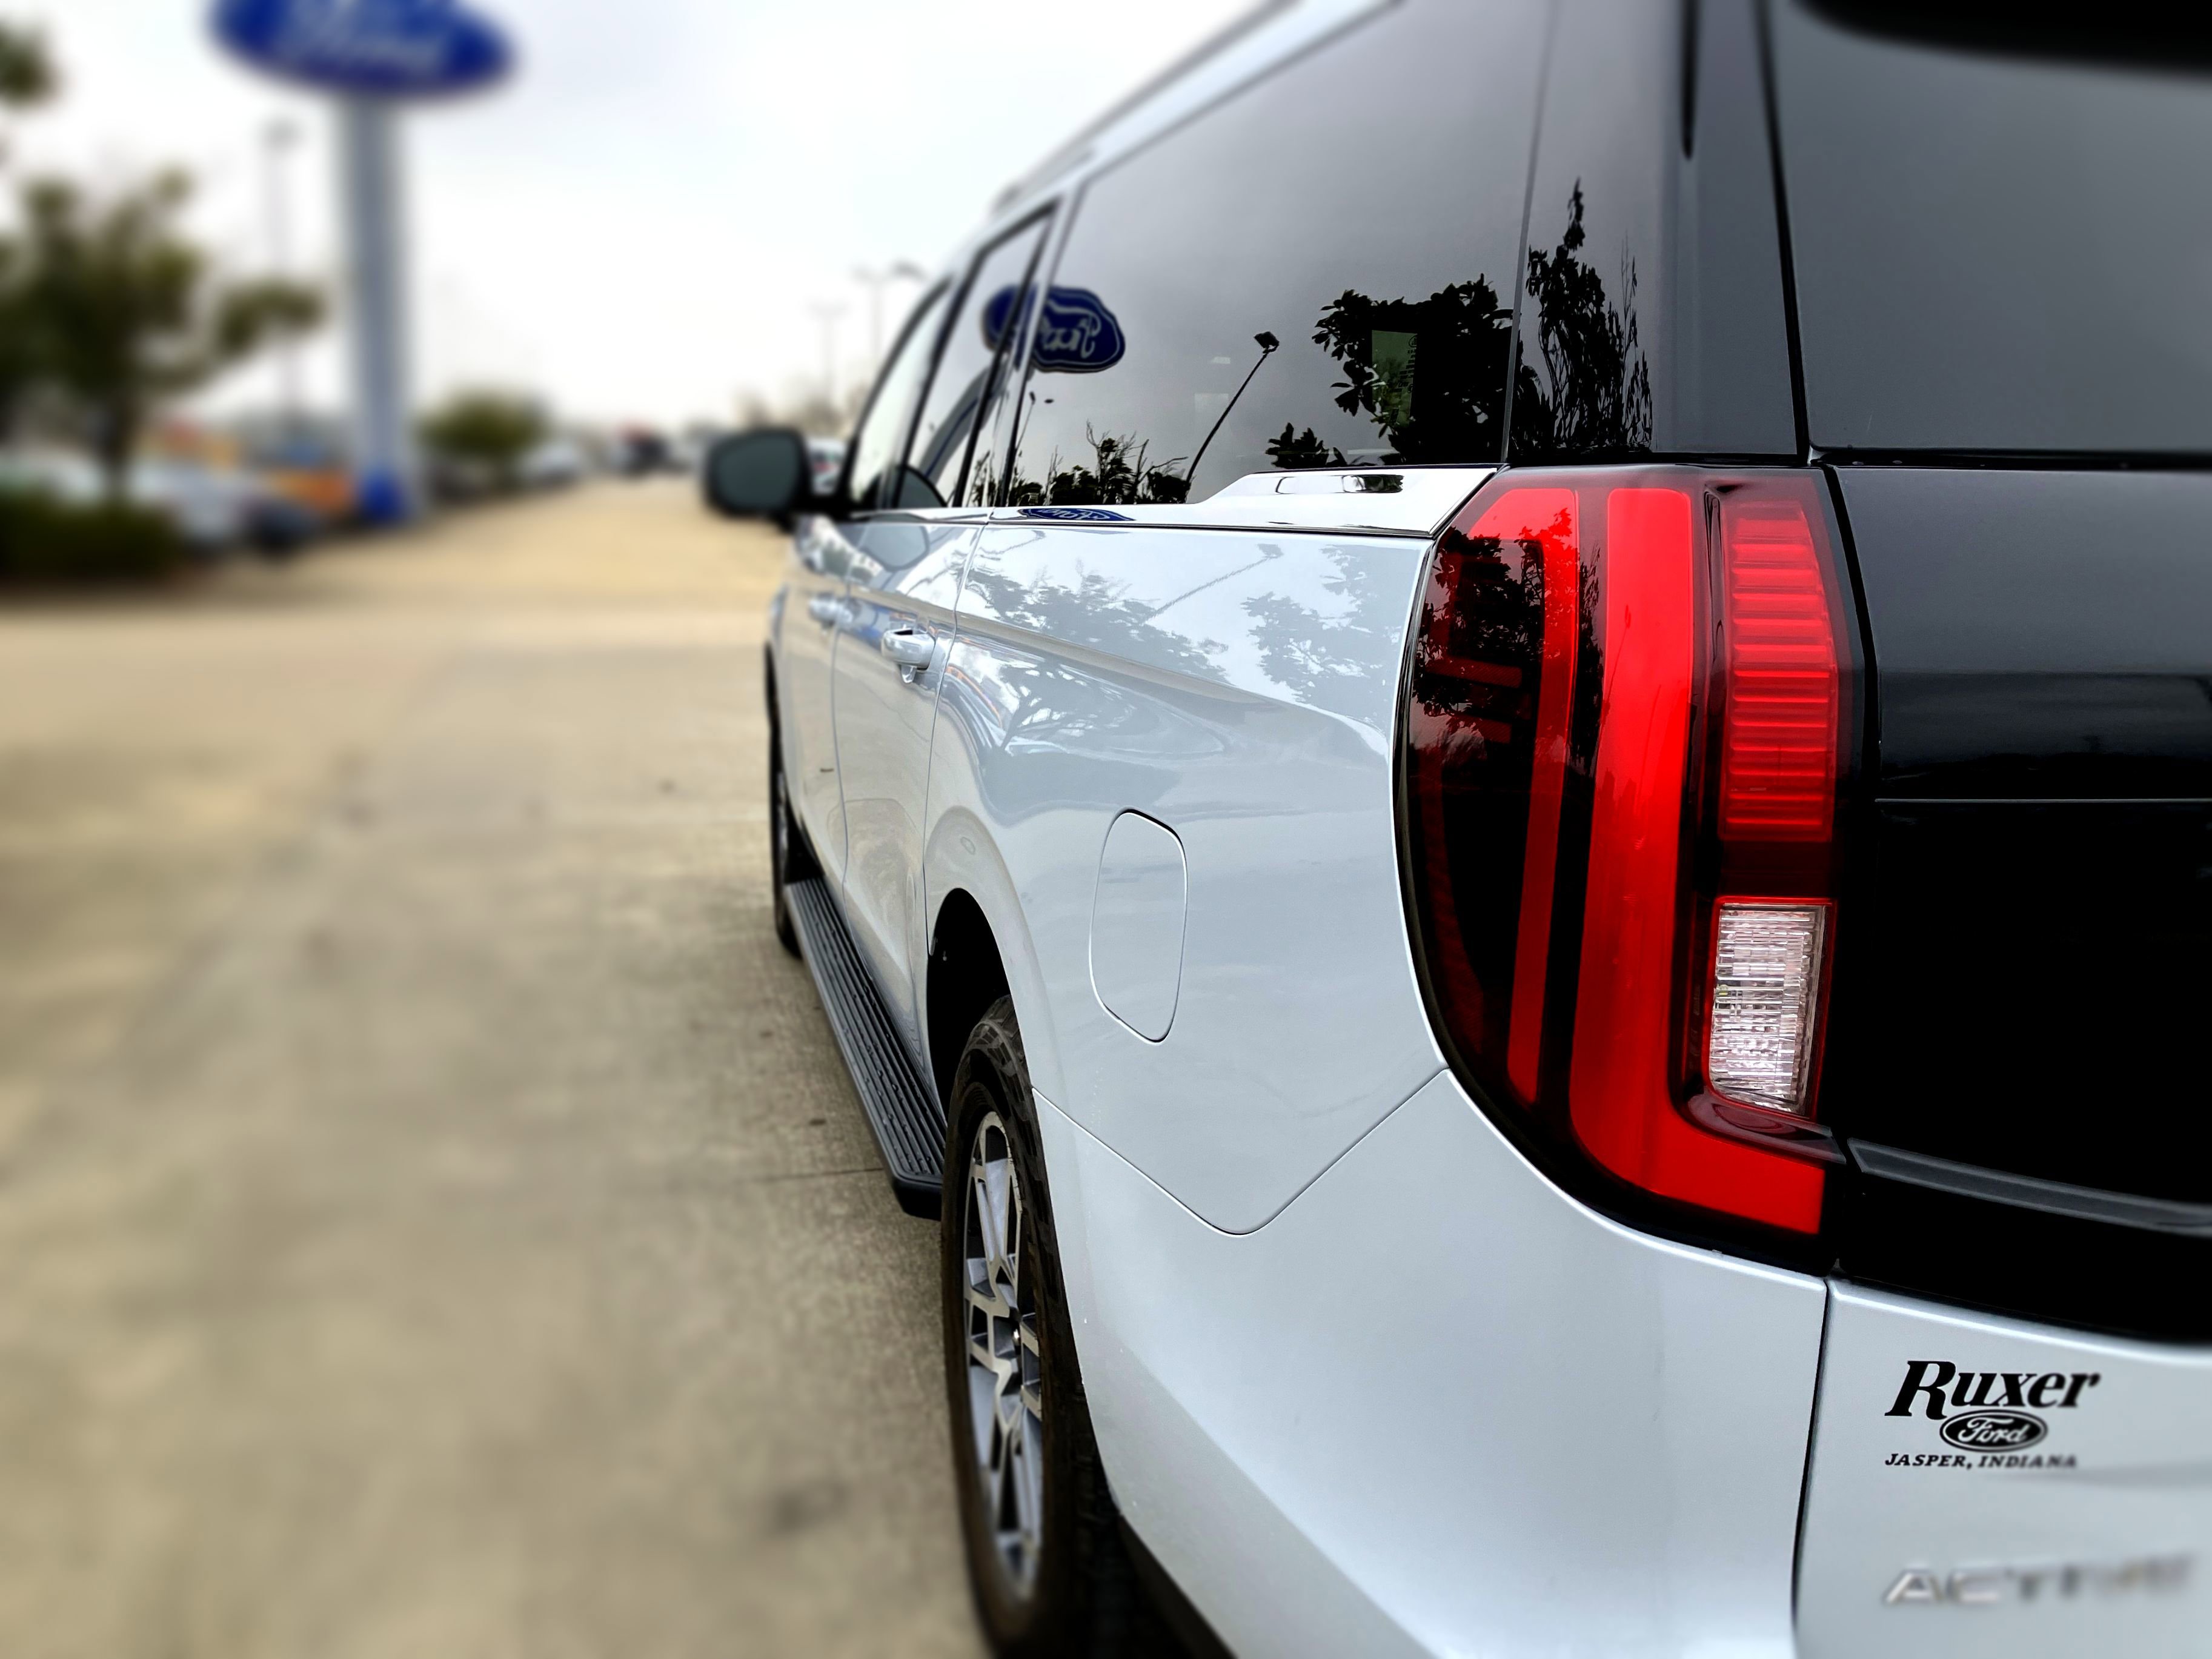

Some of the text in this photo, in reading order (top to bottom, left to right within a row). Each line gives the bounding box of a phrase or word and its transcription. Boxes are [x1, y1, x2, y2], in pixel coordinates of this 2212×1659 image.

[1884, 1360, 2101, 1420] Ruxer
[1958, 1416, 2030, 1443] Ford
[1884, 1453, 2077, 1470] JASPER, INDIANA
